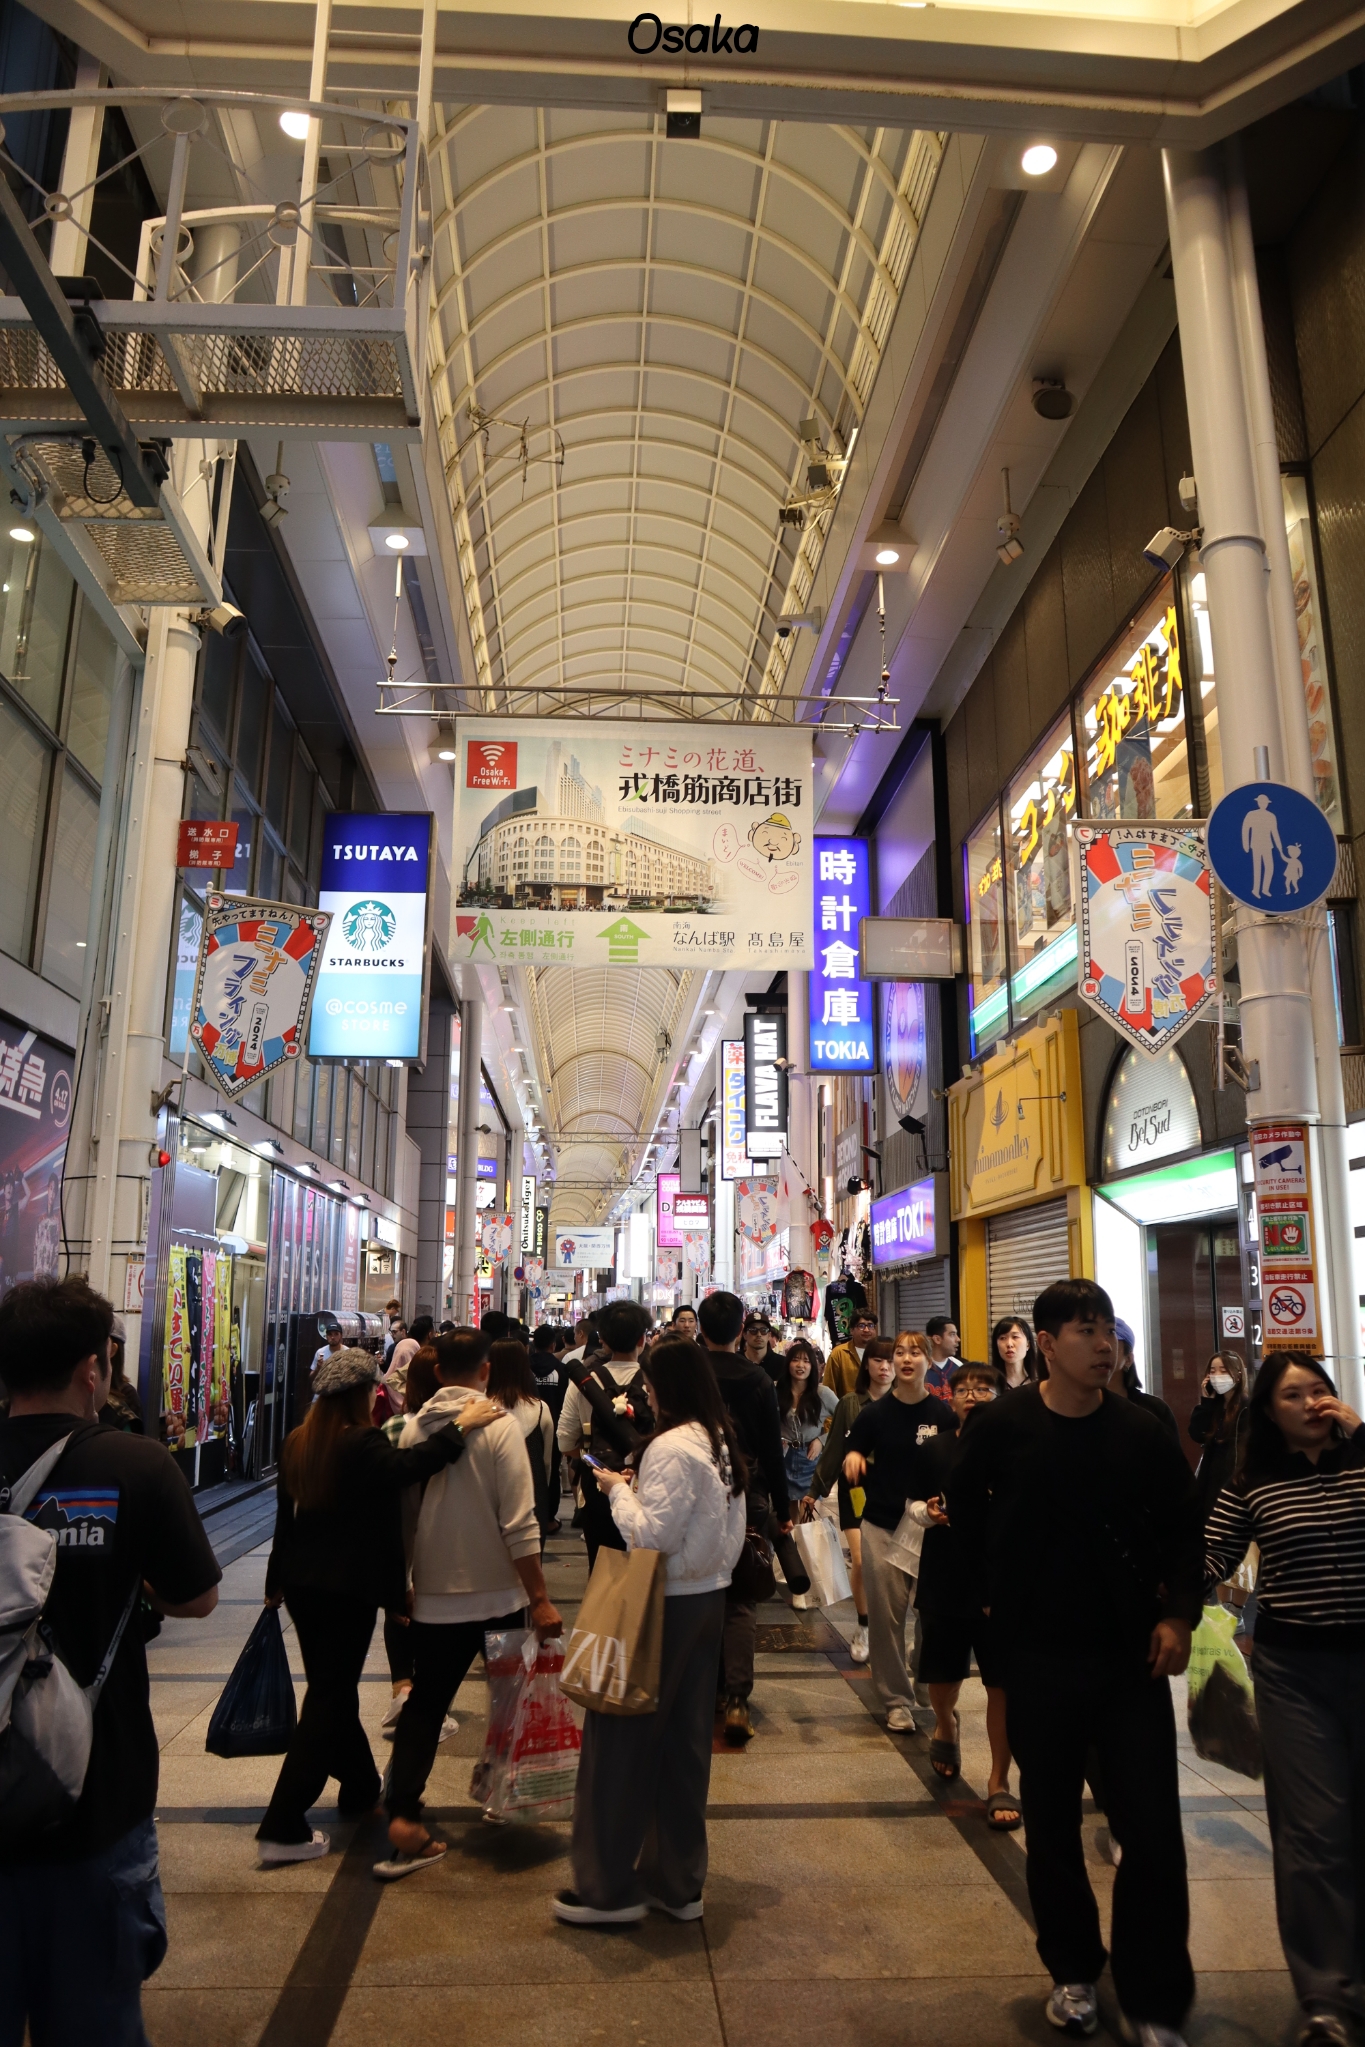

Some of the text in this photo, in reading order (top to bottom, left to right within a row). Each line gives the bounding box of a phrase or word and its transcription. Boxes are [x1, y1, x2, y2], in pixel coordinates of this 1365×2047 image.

[618, 745, 765, 773] ミナミの花道、
[472, 776, 511, 786] Free Wi-Fi
[480, 767, 504, 777] Osaka
[618, 772, 802, 808] 戎橋筋商店街
[618, 806, 722, 816] Ebisubashi-suji Shopping street
[333, 845, 418, 861] TSUTAYA
[211, 908, 294, 928] 先やってますねん!
[500, 917, 575, 926] Keep left
[500, 928, 574, 948] 左側通行
[673, 931, 735, 947] なんば駅
[820, 850, 860, 1026] 時計倉庫
[250, 925, 287, 997] ミナミ
[329, 958, 405, 967] STARBUCKS
[218, 954, 258, 1048] フライング
[325, 998, 407, 1016] @cosme
[250, 1017, 262, 1050] 2024
[341, 1020, 390, 1031] STORE
[814, 1040, 870, 1060] TOKIA
[753, 1019, 779, 1127] FLAVA HAT
[1251, 1265, 1259, 1286] 3
[1254, 1325, 1263, 1346] 2
